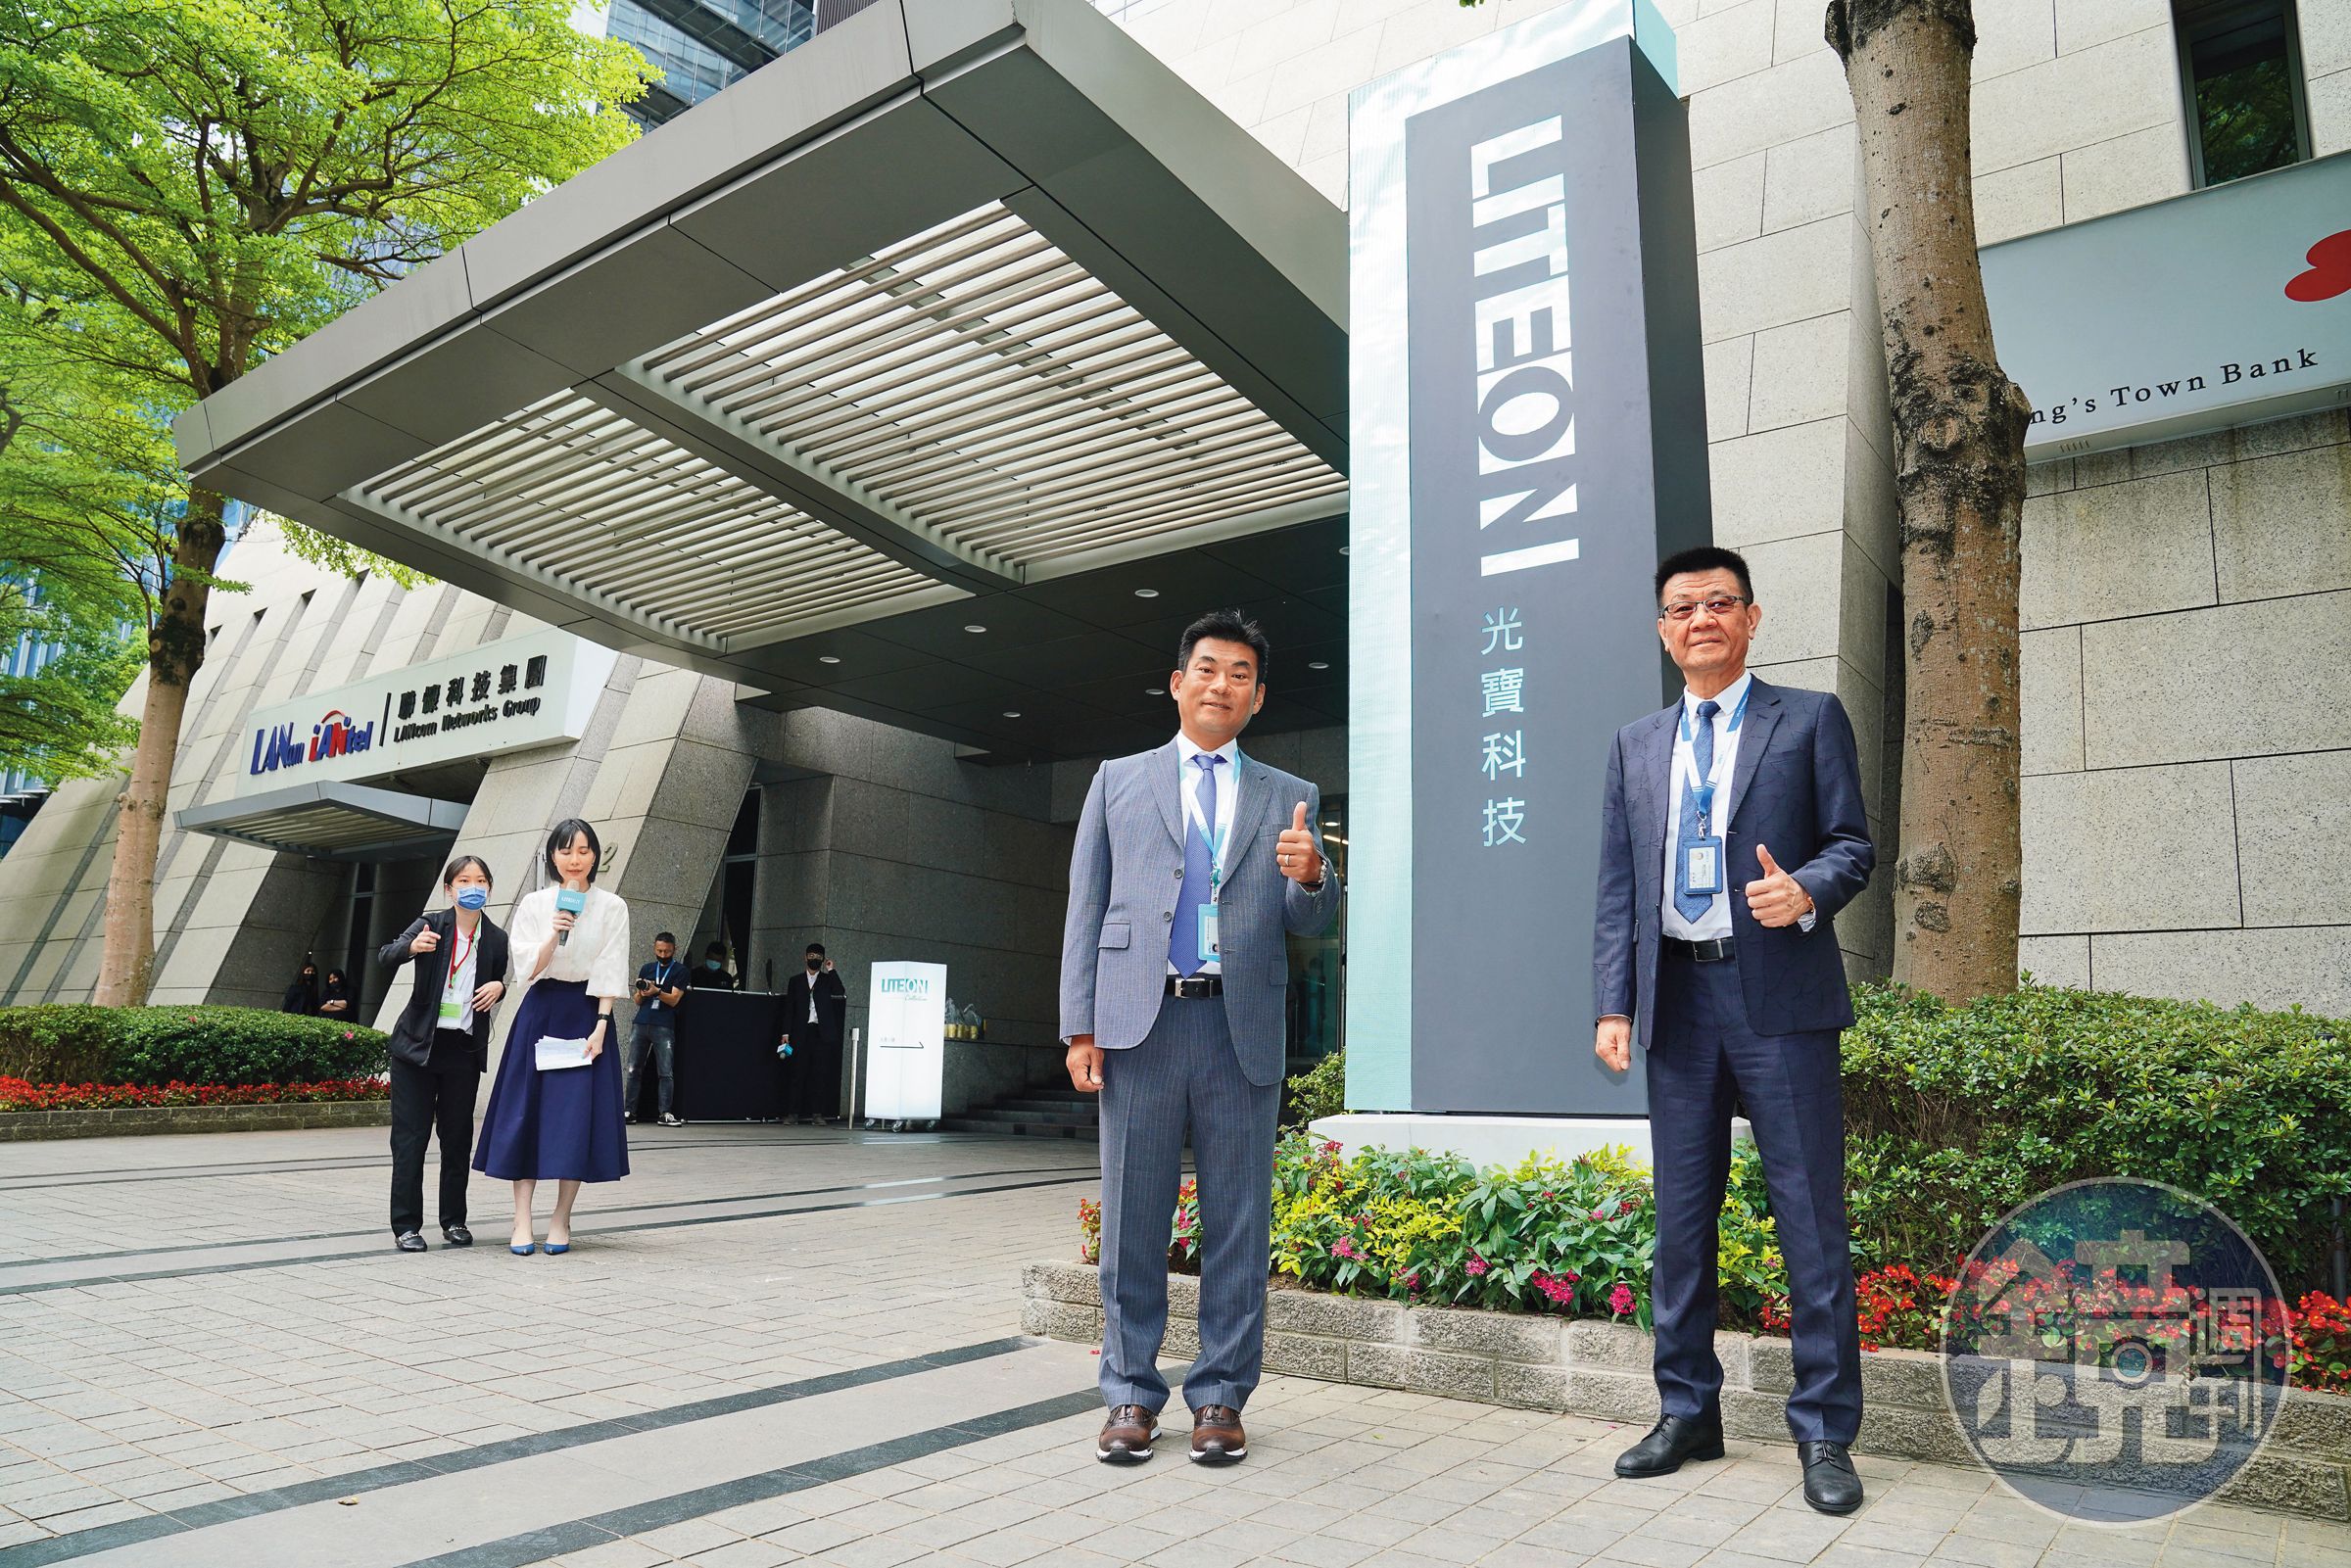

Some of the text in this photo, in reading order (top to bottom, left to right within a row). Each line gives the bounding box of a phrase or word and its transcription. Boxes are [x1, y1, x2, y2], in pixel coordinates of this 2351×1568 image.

[1470, 114, 1580, 577] LITEON
[2110, 376, 2206, 407] Town
[2220, 348, 2319, 386] Bank
[441, 704, 499, 733] Networks
[503, 696, 541, 718] Group
[1480, 611, 1527, 847] 光寶科技
[882, 978, 929, 993] LITEON
